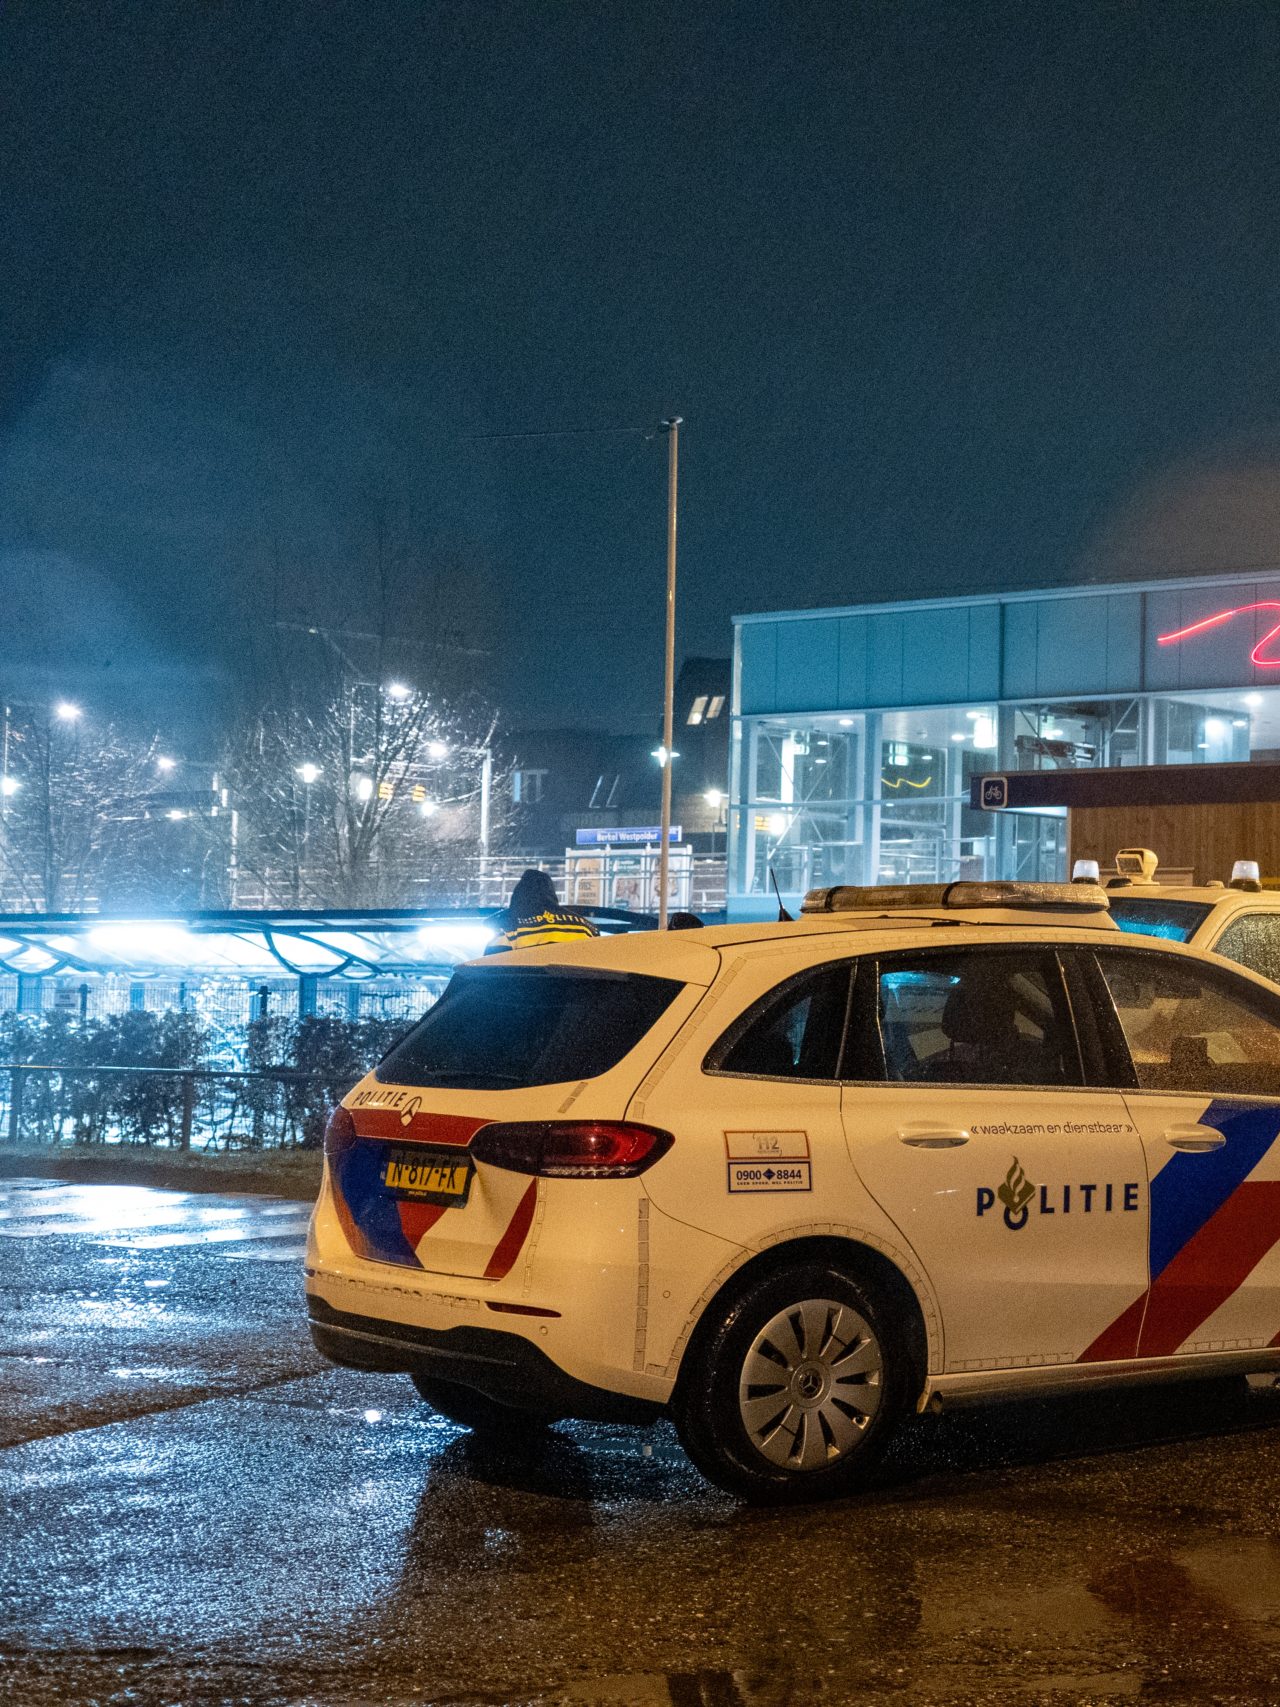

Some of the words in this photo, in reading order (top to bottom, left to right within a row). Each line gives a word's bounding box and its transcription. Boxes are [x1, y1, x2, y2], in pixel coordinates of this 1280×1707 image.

[619, 831, 658, 842] Westpolder
[352, 1090, 408, 1107] POLITIE
[980, 1122, 1046, 1134] waakzaam
[1047, 1123, 1061, 1134] en
[1063, 1121, 1123, 1134] dienstbaar
[756, 1136, 780, 1150] 112
[736, 1169, 762, 1181] 0900
[776, 1169, 802, 1180] 8844
[976, 1183, 1139, 1231] POLITIE
